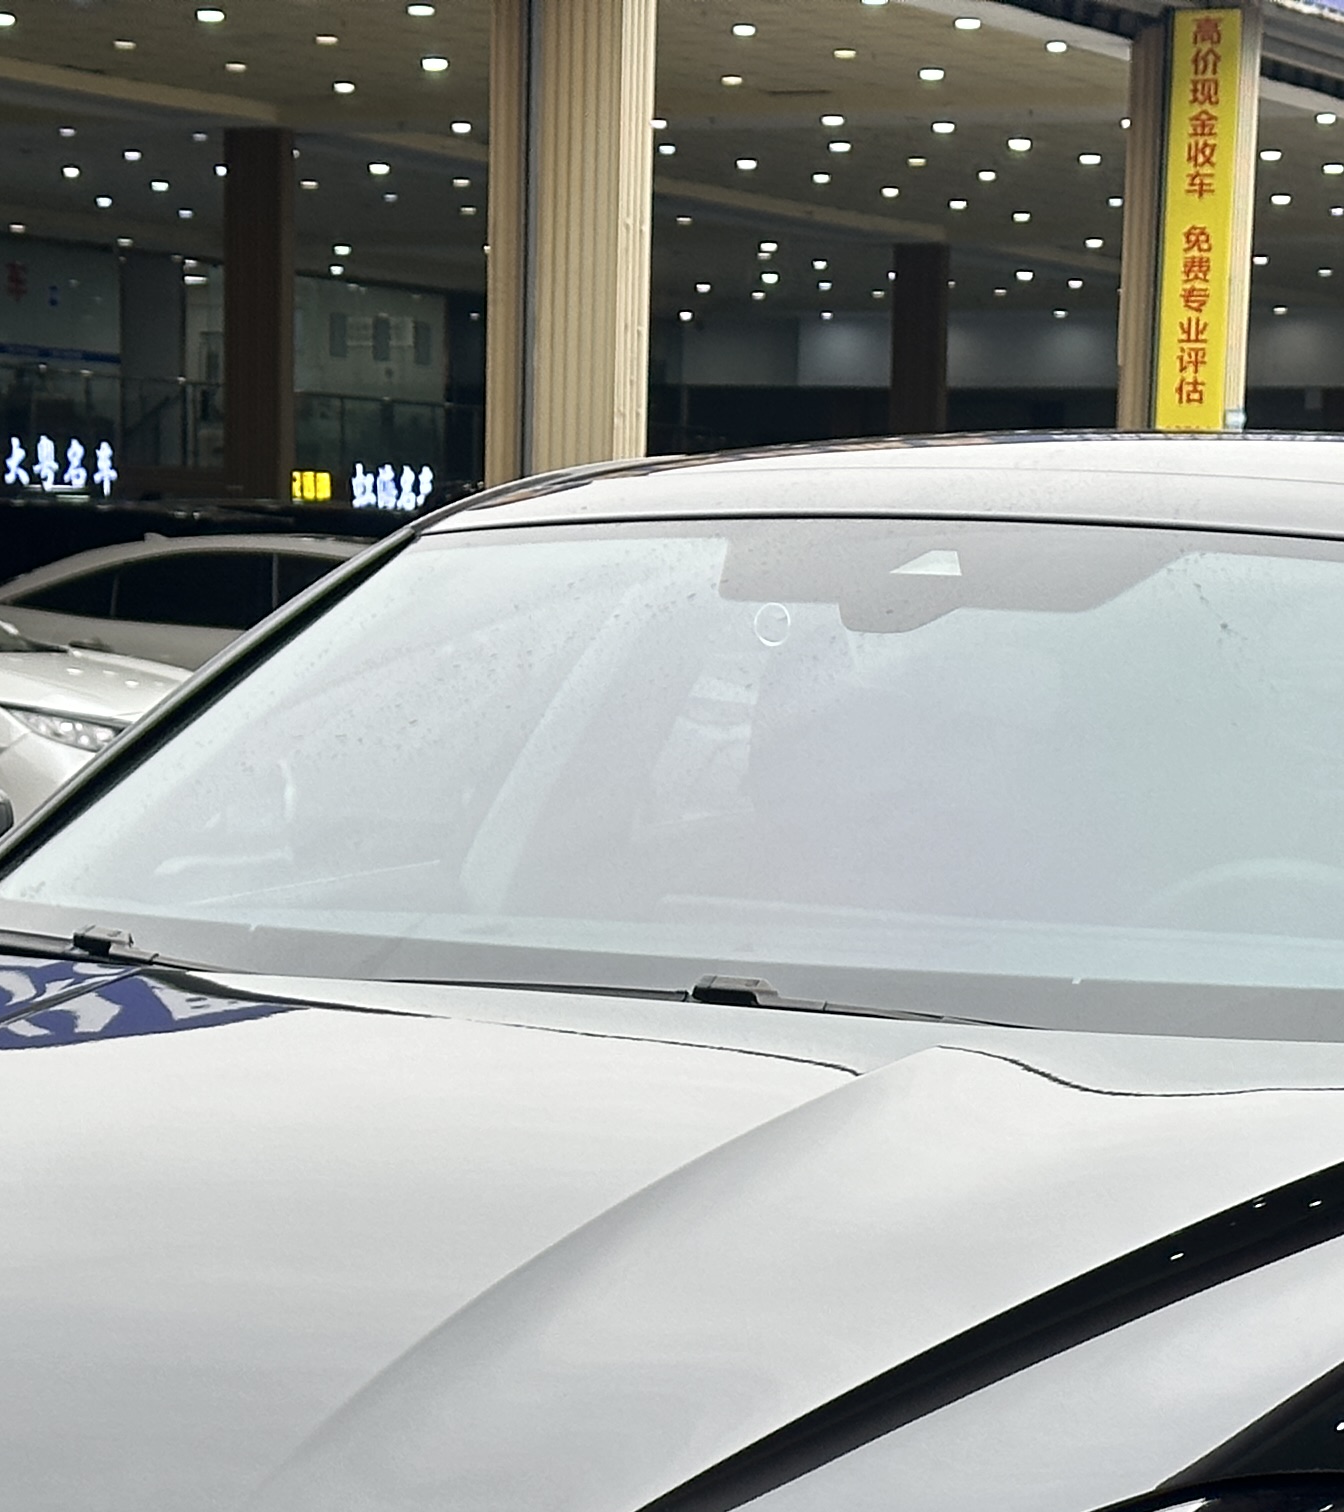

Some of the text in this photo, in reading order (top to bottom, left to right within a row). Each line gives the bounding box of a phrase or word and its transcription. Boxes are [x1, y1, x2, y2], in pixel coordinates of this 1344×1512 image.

[1184, 16, 1222, 200] 高价现金收车
[1174, 224, 1213, 406] 免费专业评估
